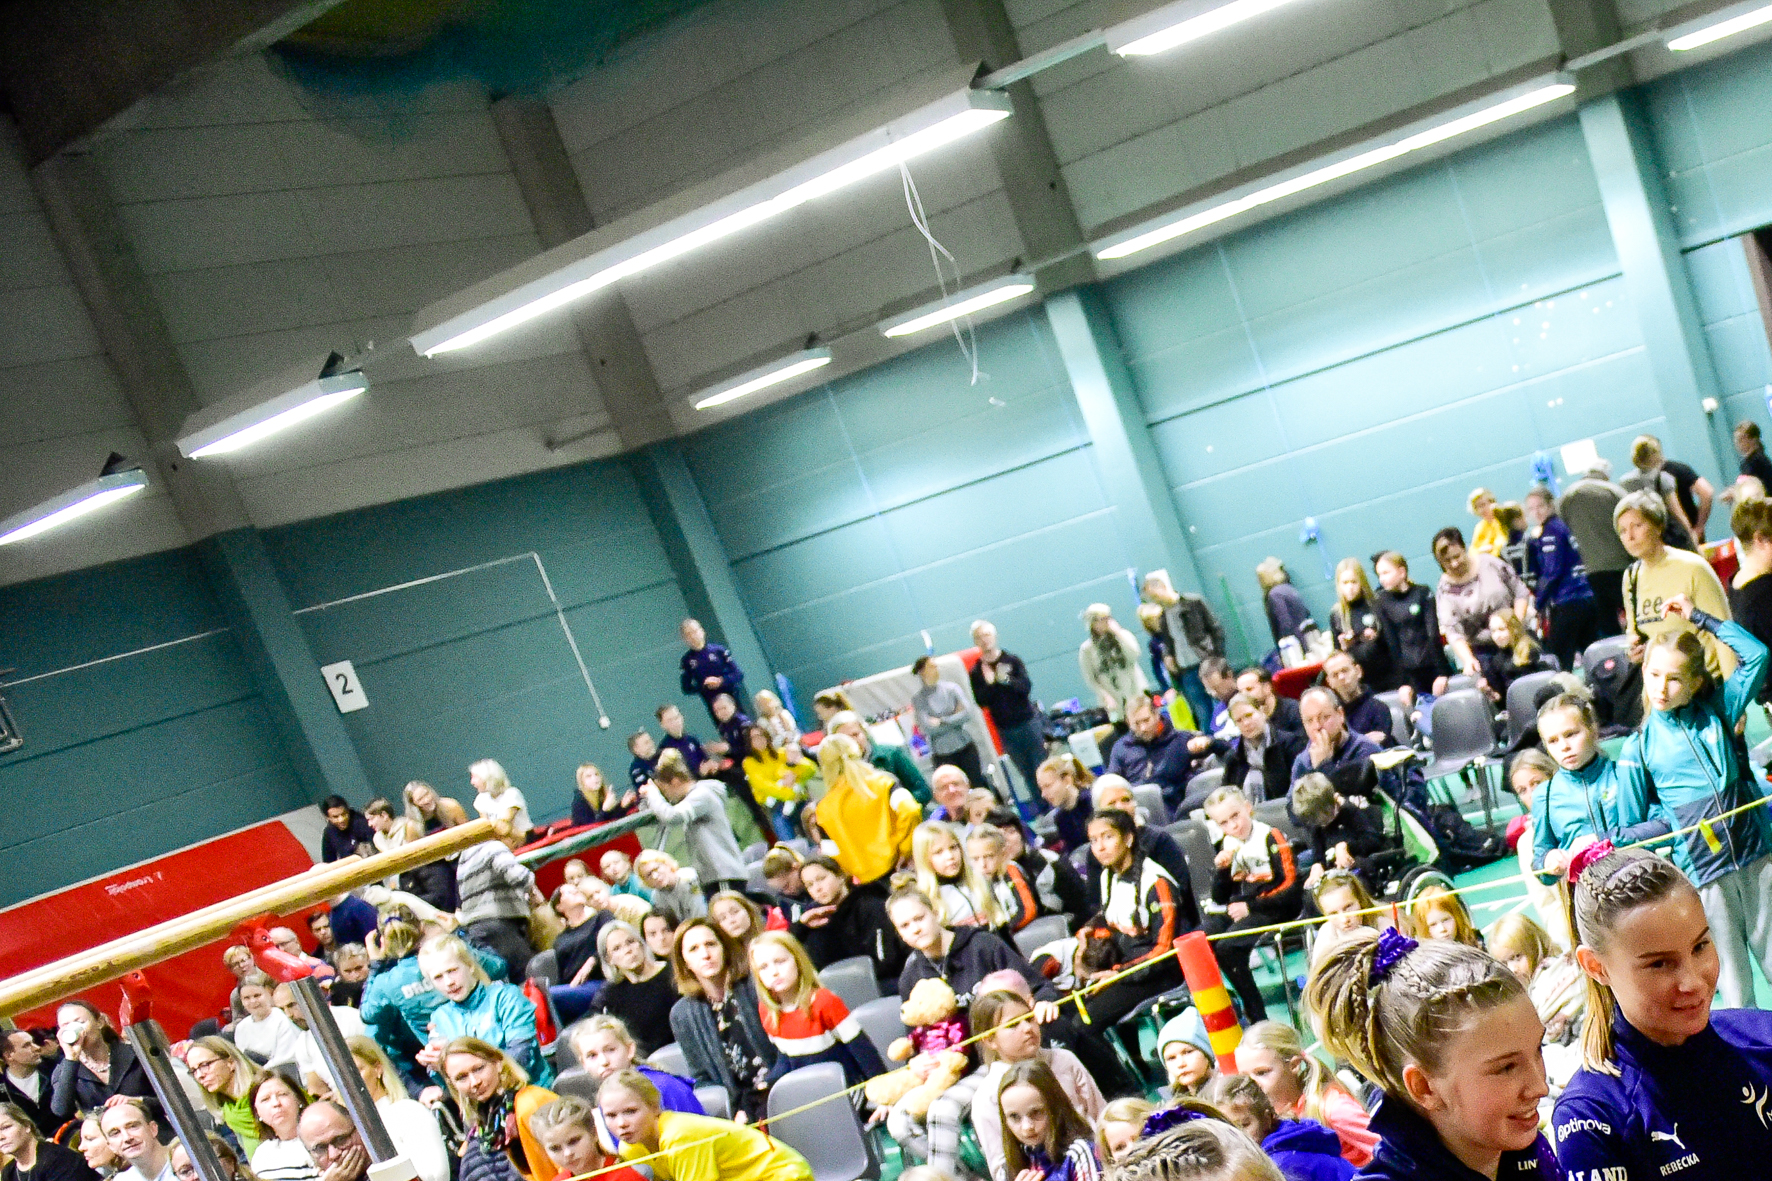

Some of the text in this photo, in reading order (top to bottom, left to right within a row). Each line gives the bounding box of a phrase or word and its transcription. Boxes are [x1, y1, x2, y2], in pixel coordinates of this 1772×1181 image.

[335, 673, 354, 695] 2
[1517, 1158, 1538, 1171] LIN
[1660, 1152, 1700, 1177] REBECKA
